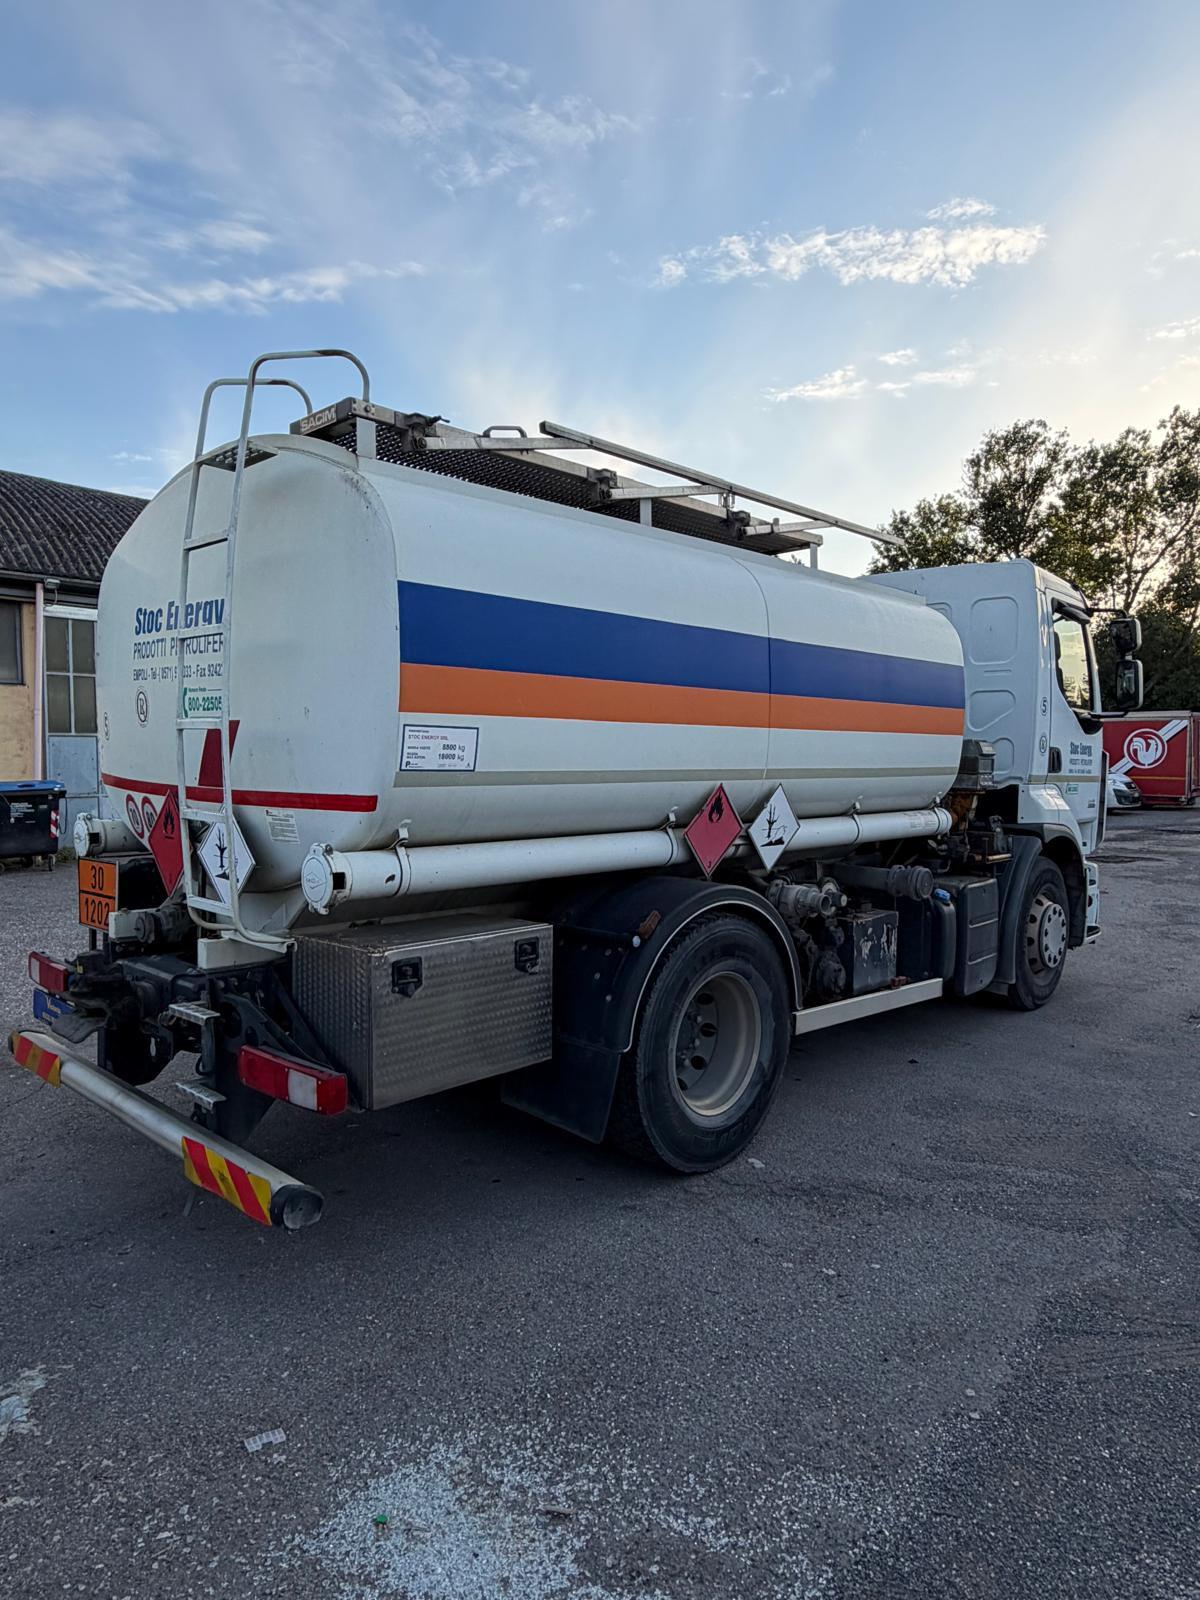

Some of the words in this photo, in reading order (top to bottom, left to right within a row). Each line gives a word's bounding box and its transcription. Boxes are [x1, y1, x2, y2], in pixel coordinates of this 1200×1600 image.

[300, 407, 336, 431] SACIM
[135, 607, 163, 636] Stoc
[133, 637, 166, 660] PRODOTTI
[196, 664, 206, 678] Fax
[91, 865, 104, 891] 30
[85, 897, 110, 927] 1202
